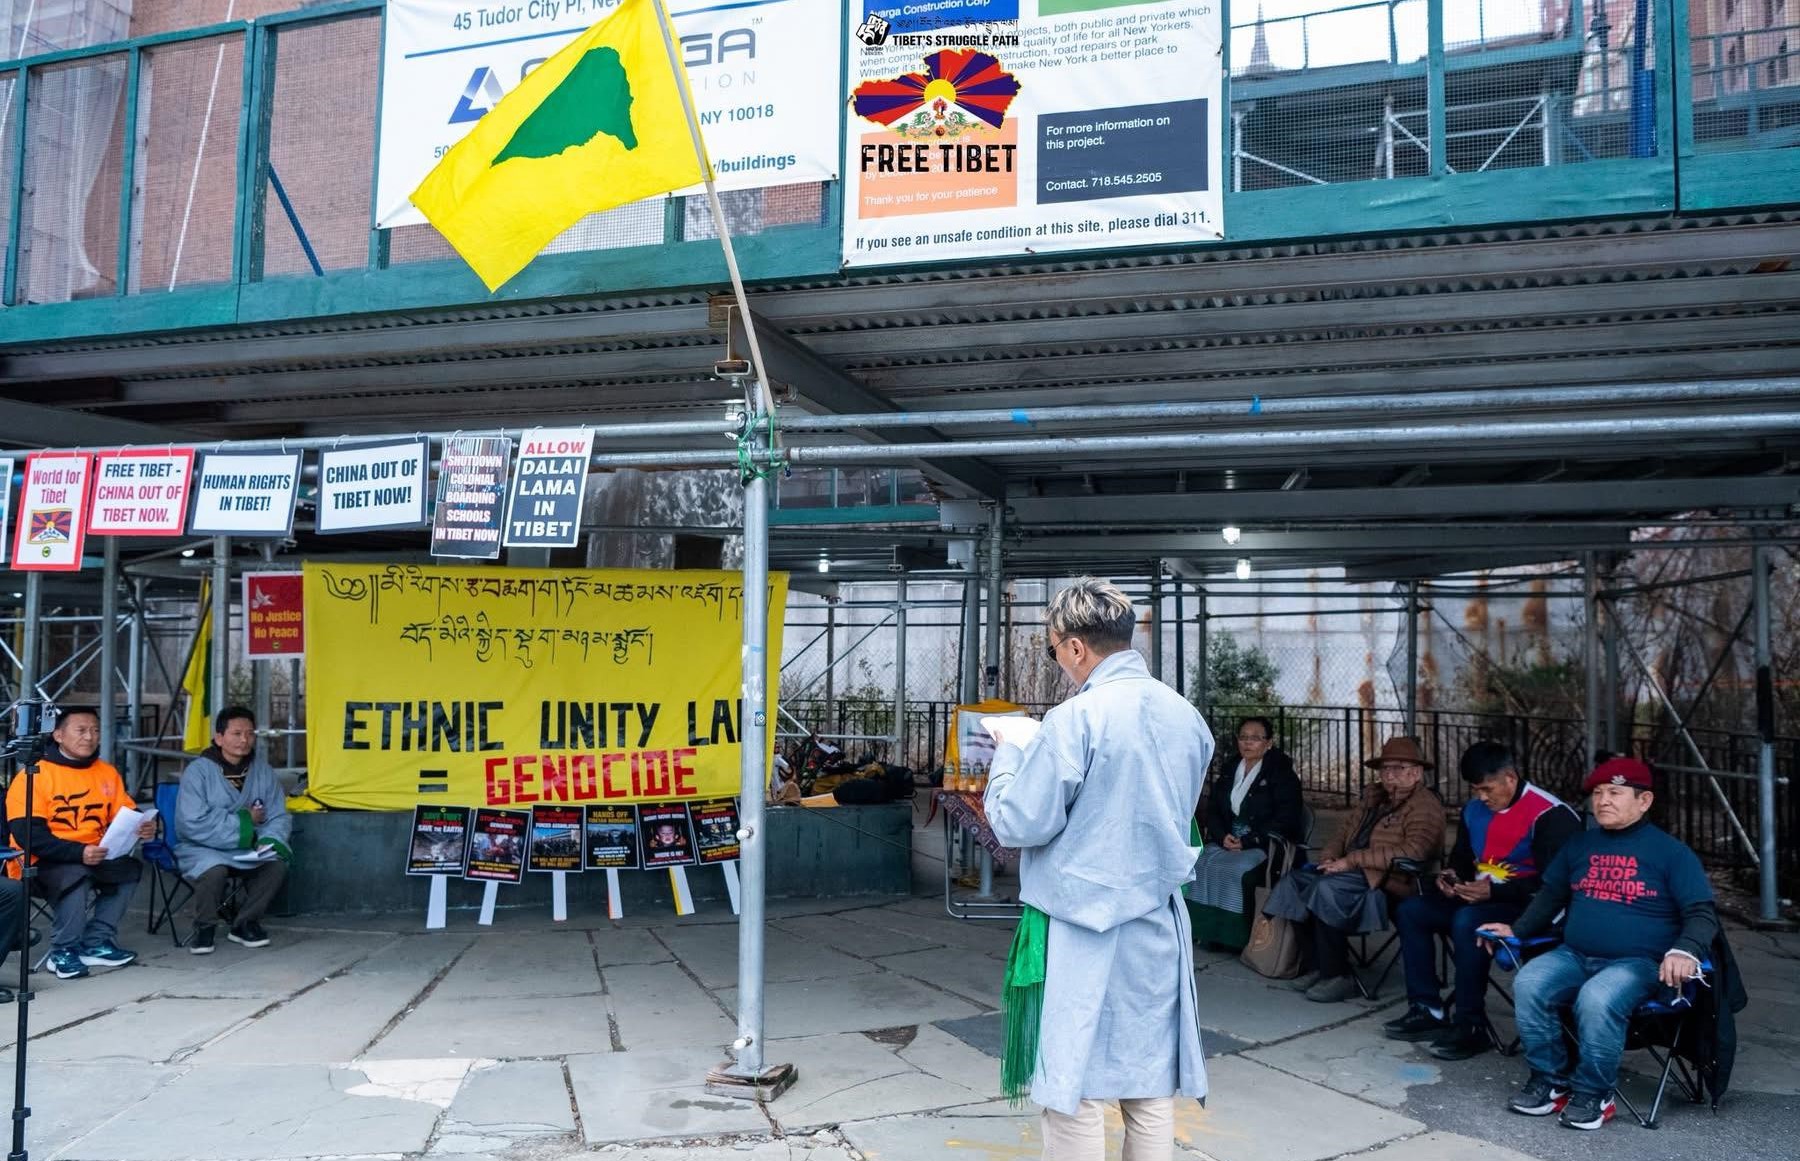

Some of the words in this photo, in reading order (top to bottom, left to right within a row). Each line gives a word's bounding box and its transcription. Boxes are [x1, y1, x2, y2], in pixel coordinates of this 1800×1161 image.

[453, 12, 472, 31] 45
[477, 6, 523, 28] Tudor
[528, 0, 560, 21] City
[592, 0, 621, 9] Ne
[903, 0, 963, 15] Construction
[1054, 22, 1077, 33] both
[1081, 18, 1113, 30] public
[1116, 14, 1136, 25] and
[1139, 11, 1175, 25] private
[1178, 6, 1211, 19] which
[860, 56, 885, 67] when
[1023, 37, 1057, 48] quality
[1061, 35, 1070, 43] of
[1074, 32, 1088, 41] life
[1091, 30, 1104, 39] for
[1108, 28, 1120, 37] all
[1124, 26, 1147, 36] New
[860, 66, 899, 78] Whether
[1054, 44, 1077, 55] road
[1081, 40, 1117, 53] repairs
[1120, 38, 1131, 47] or
[1135, 35, 1158, 47] park
[1008, 58, 1035, 70] make
[1039, 57, 1062, 68] New
[1065, 54, 1087, 66] York
[1101, 50, 1132, 61] better
[1135, 47, 1163, 59] place
[1167, 45, 1177, 54] to
[701, 110, 722, 125] NY
[728, 104, 774, 122] 10018
[1046, 126, 1063, 136] For
[1066, 123, 1093, 134] more
[1095, 118, 1153, 131] information
[1156, 116, 1170, 126] on
[1046, 139, 1064, 149] this
[1067, 136, 1105, 150] project.
[1091, 172, 1162, 188] 718.545.2505
[864, 194, 895, 206] Thank
[896, 194, 914, 205] you
[916, 192, 929, 201] for
[931, 191, 954, 203] your
[955, 186, 998, 200] patience
[856, 237, 864, 249] If
[867, 238, 887, 251] you
[891, 236, 911, 247] see
[915, 235, 929, 246] an
[933, 229, 972, 244] unsafe
[976, 225, 1031, 241] condition
[1036, 224, 1047, 236] at
[1051, 221, 1073, 234] this
[1108, 217, 1150, 233] please
[1154, 212, 1177, 226] dial
[1182, 211, 1211, 224] 311.
[525, 441, 586, 455] ALLOW
[447, 455, 503, 467] SHUTDOWN
[522, 459, 580, 475] DALAI
[32, 469, 62, 485] World
[105, 464, 134, 478] FREE
[138, 463, 173, 477] TIBET
[326, 463, 368, 484] CHINA
[371, 461, 399, 480] OUT
[401, 458, 418, 477] OF
[203, 475, 246, 490] HUMAN
[249, 474, 291, 490] RIGHTS
[450, 473, 495, 485] COLONIAL
[98, 486, 134, 500] CHINA
[138, 486, 162, 499] OUT
[166, 486, 182, 499] OF
[519, 479, 577, 496] LAMA
[41, 488, 67, 504] Tibet
[219, 497, 232, 511] IN
[235, 497, 271, 511] TIBET!
[333, 490, 372, 509] TIBET
[374, 486, 412, 506] NOW!
[446, 491, 496, 504] BOARDING
[103, 509, 135, 522] TIBET
[138, 508, 169, 522] NOW.
[534, 500, 555, 516] IN
[446, 510, 491, 523] SCHOOLS
[435, 527, 446, 539] IN
[447, 528, 473, 540] TIBET
[474, 529, 499, 541] NOW
[513, 521, 572, 537] TIBET
[251, 612, 264, 623] No
[265, 610, 301, 622] Justice
[255, 627, 266, 638] No
[269, 627, 299, 638] Peace
[343, 701, 504, 752] ETHNIC
[540, 700, 660, 750] UNITY
[688, 698, 743, 746] LA
[484, 748, 697, 806] GENOCIDE
[1590, 855, 1638, 868] CHINA
[1588, 866, 1638, 880] STOP
[1580, 878, 1646, 897] GENOCIDE
